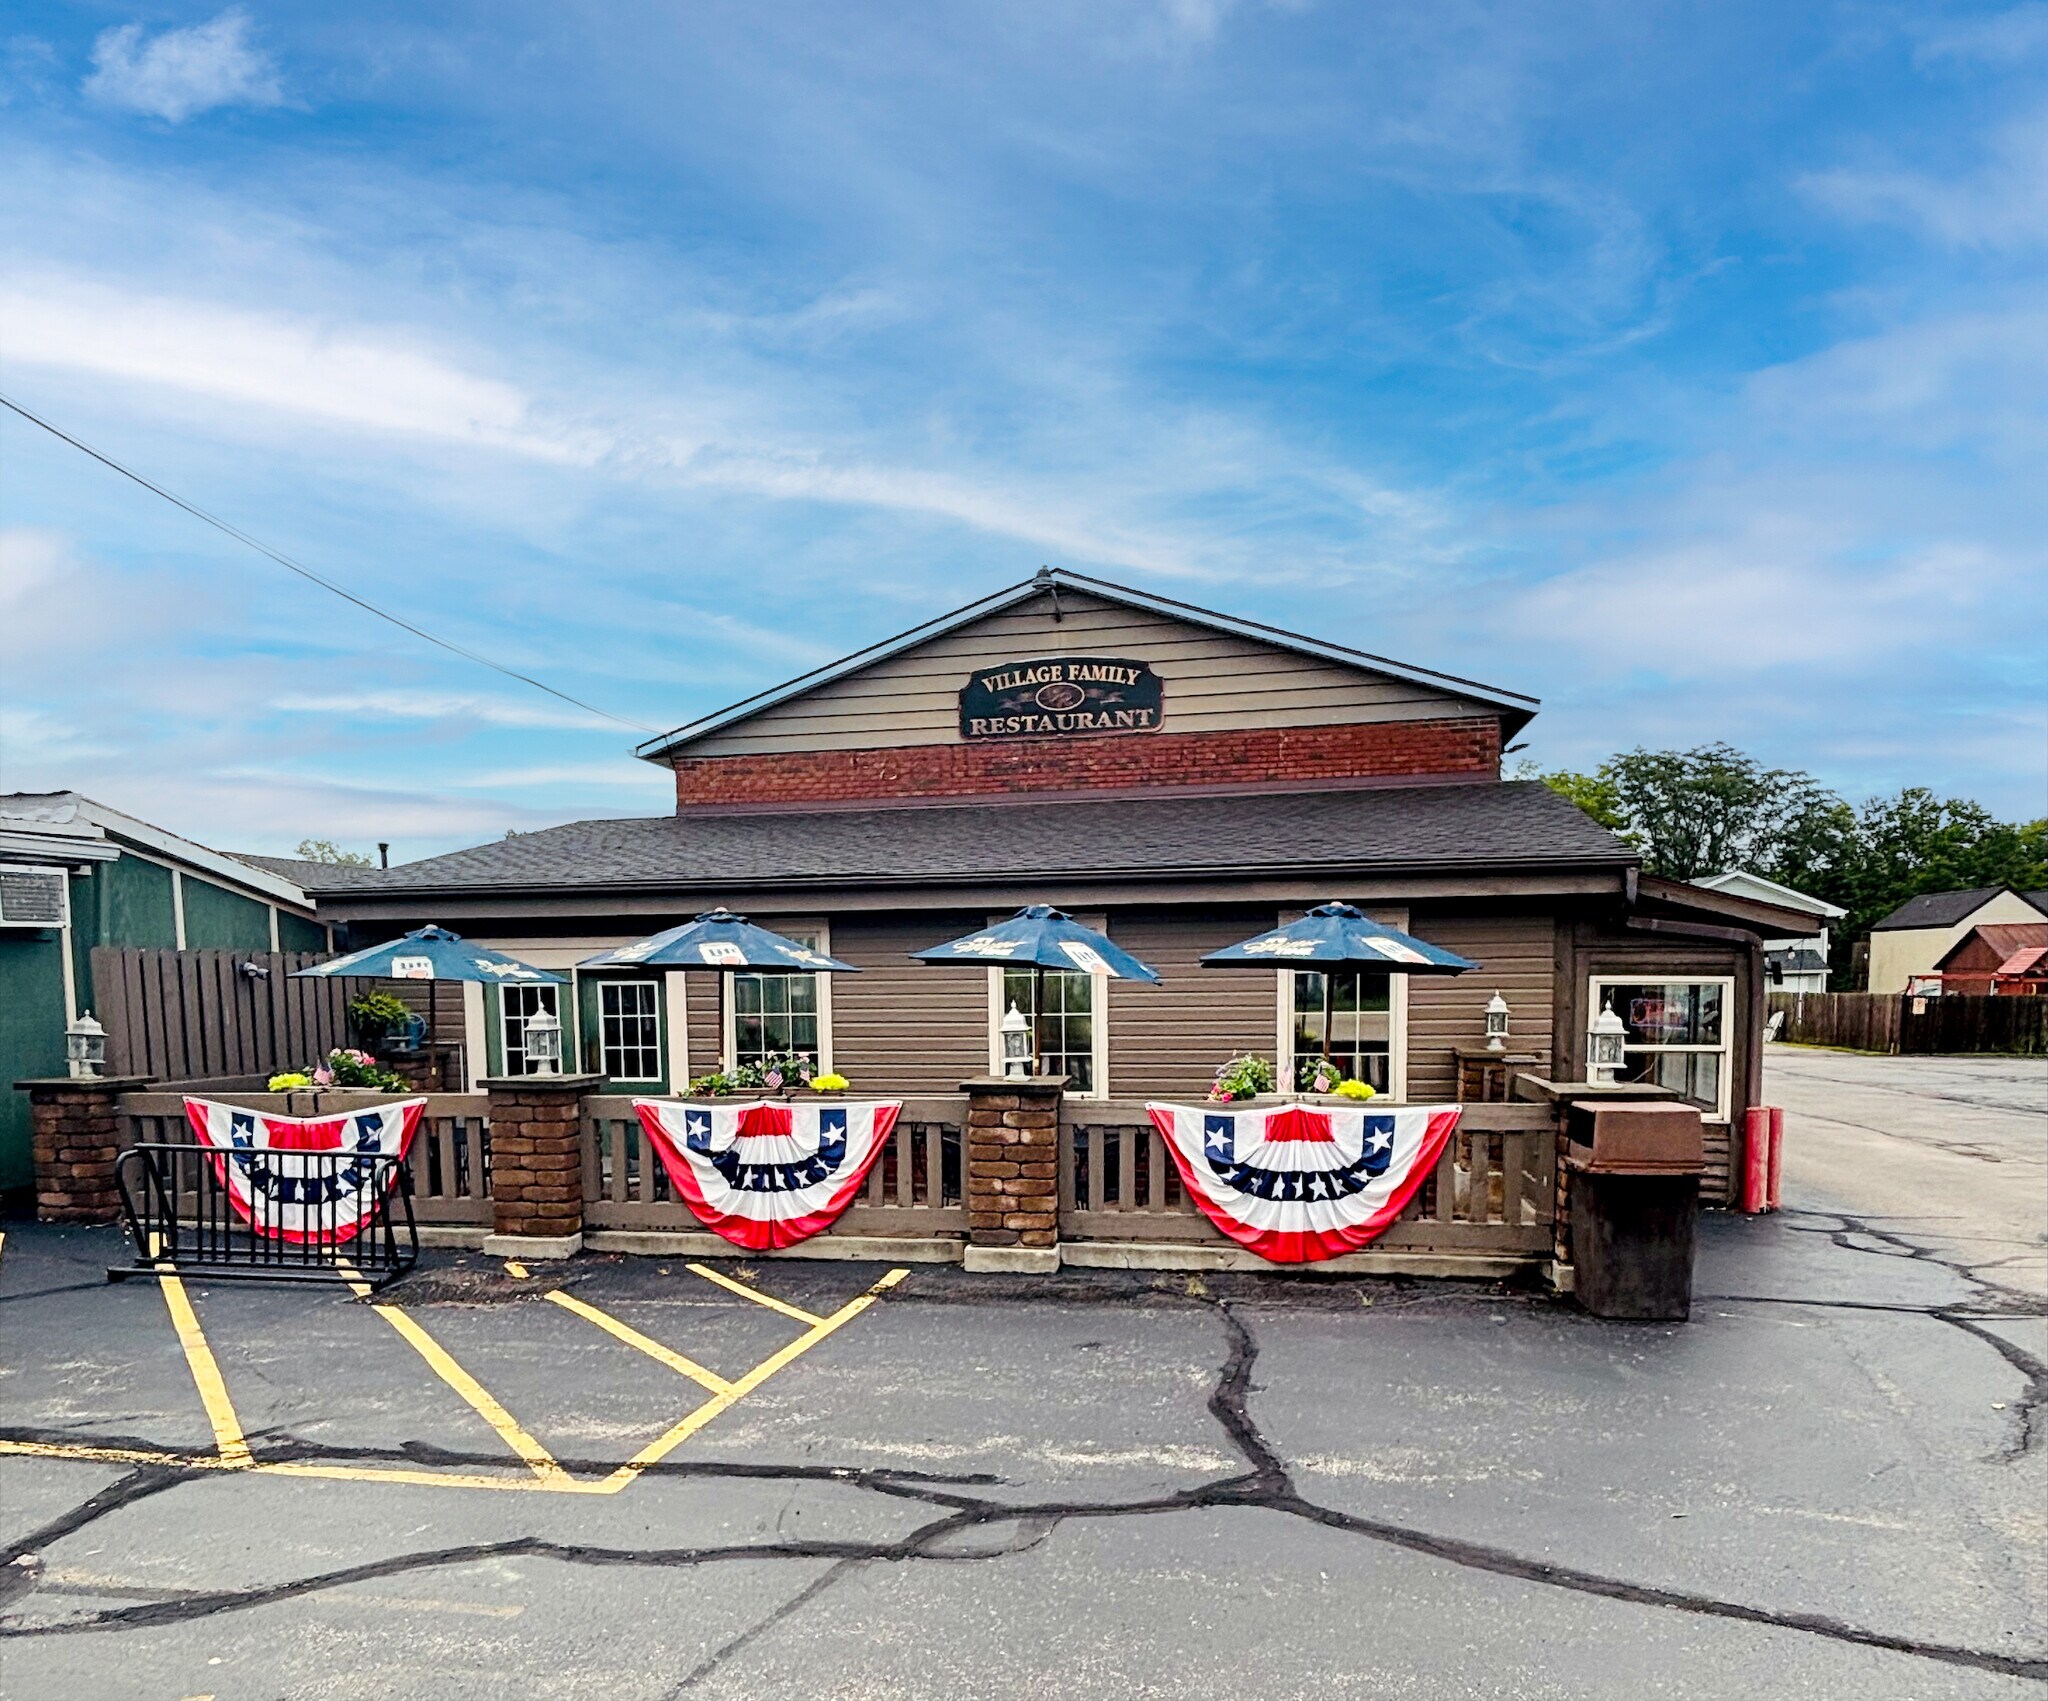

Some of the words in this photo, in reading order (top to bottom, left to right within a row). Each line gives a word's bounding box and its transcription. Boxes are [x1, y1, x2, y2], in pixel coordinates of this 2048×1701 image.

[981, 665, 1063, 694] VILLAGE
[1068, 664, 1142, 686] FAMILY
[969, 708, 1154, 735] RESTAURANT
